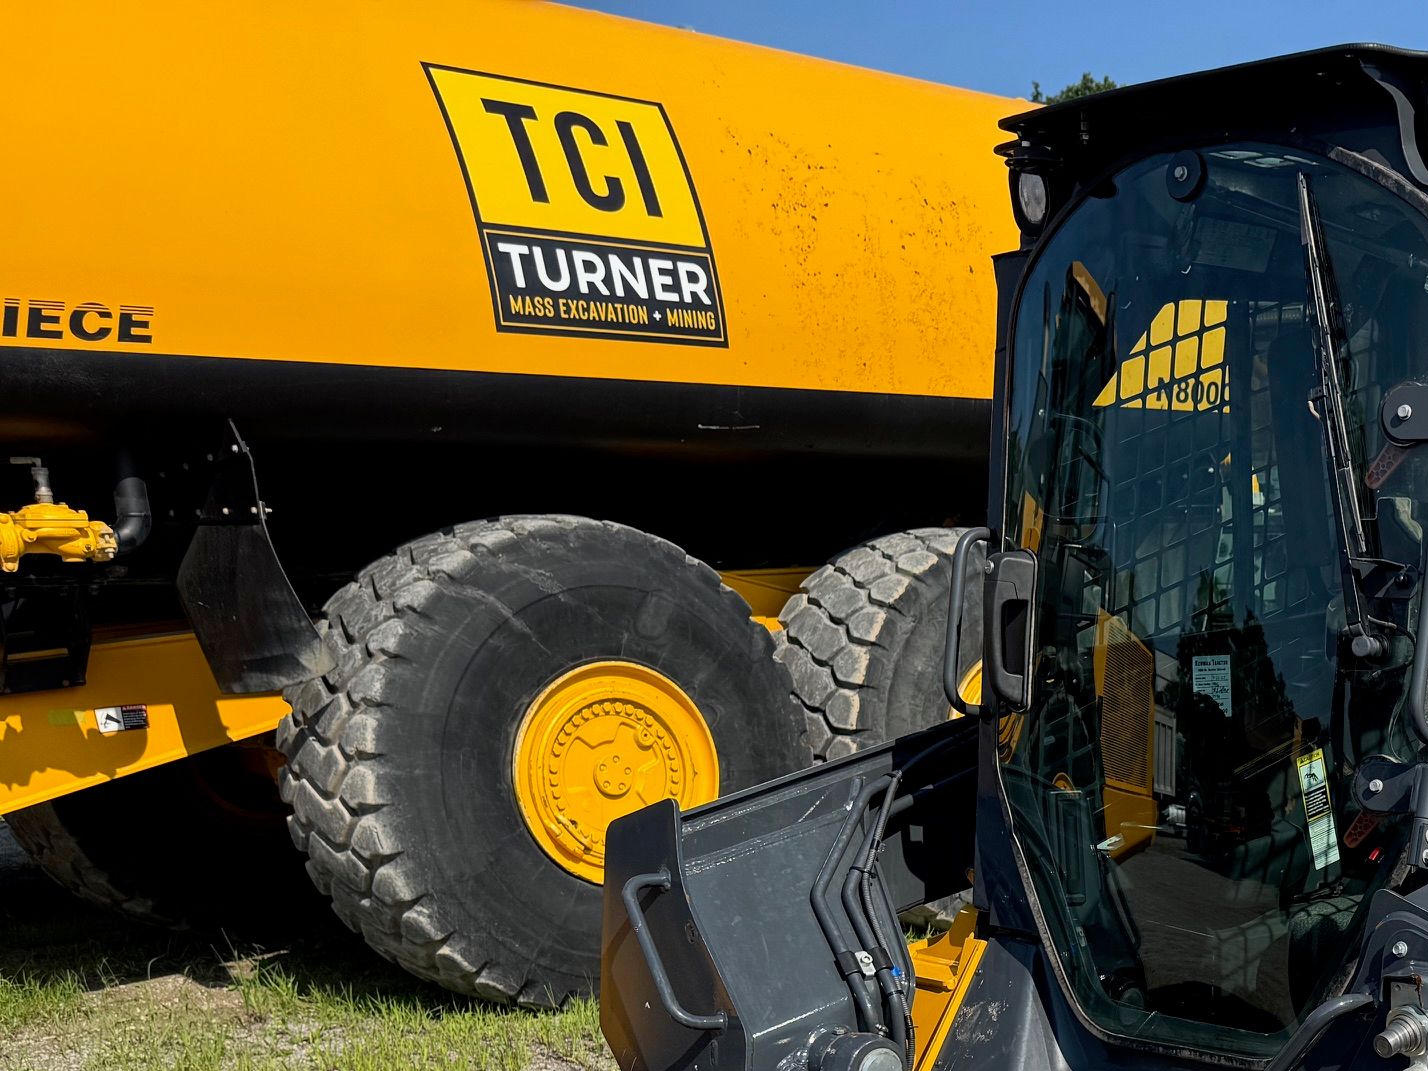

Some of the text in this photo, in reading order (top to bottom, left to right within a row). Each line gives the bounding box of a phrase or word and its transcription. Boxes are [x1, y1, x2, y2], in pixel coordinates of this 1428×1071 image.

[480, 98, 663, 218] TCI
[497, 242, 712, 305] TURNER
[509, 295, 555, 318] MASS
[559, 299, 648, 325] EXCAVATION
[666, 308, 716, 331] MINING
